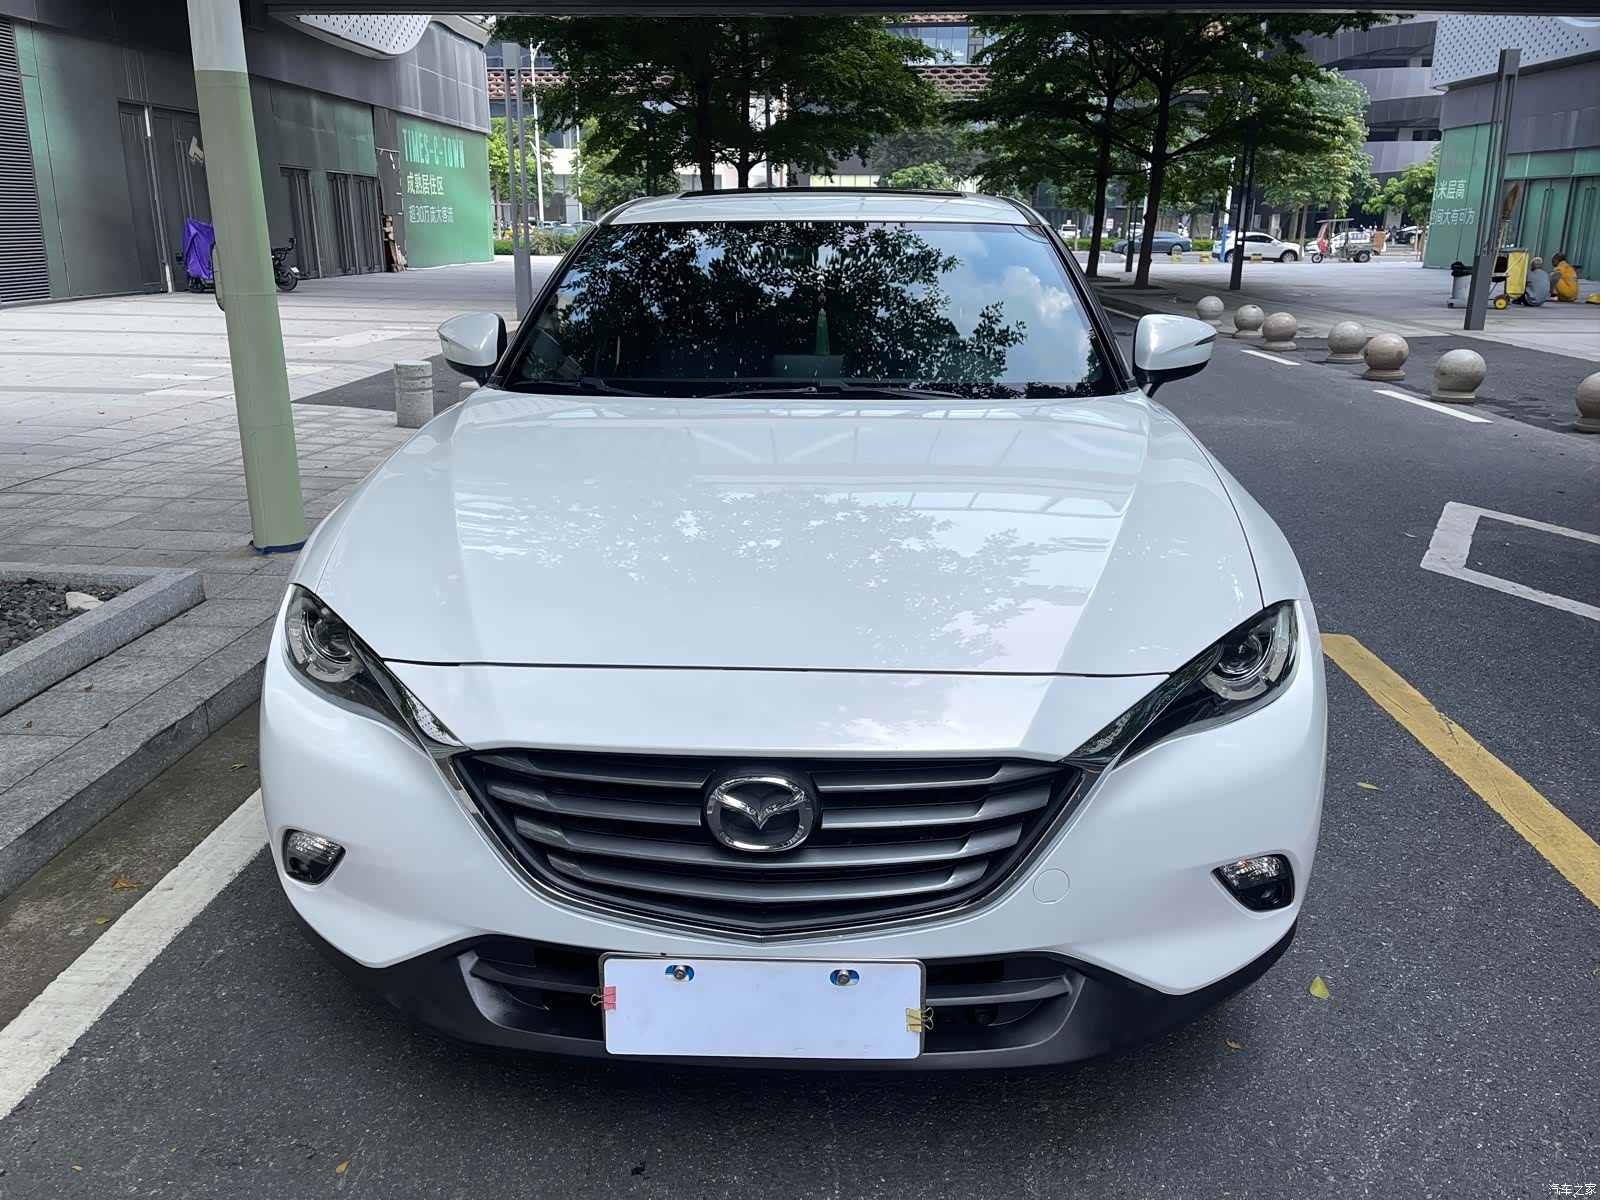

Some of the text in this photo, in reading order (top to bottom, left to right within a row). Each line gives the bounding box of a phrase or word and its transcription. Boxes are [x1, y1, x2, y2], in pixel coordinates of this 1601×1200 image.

[406, 171, 445, 196] 成熟居住区
